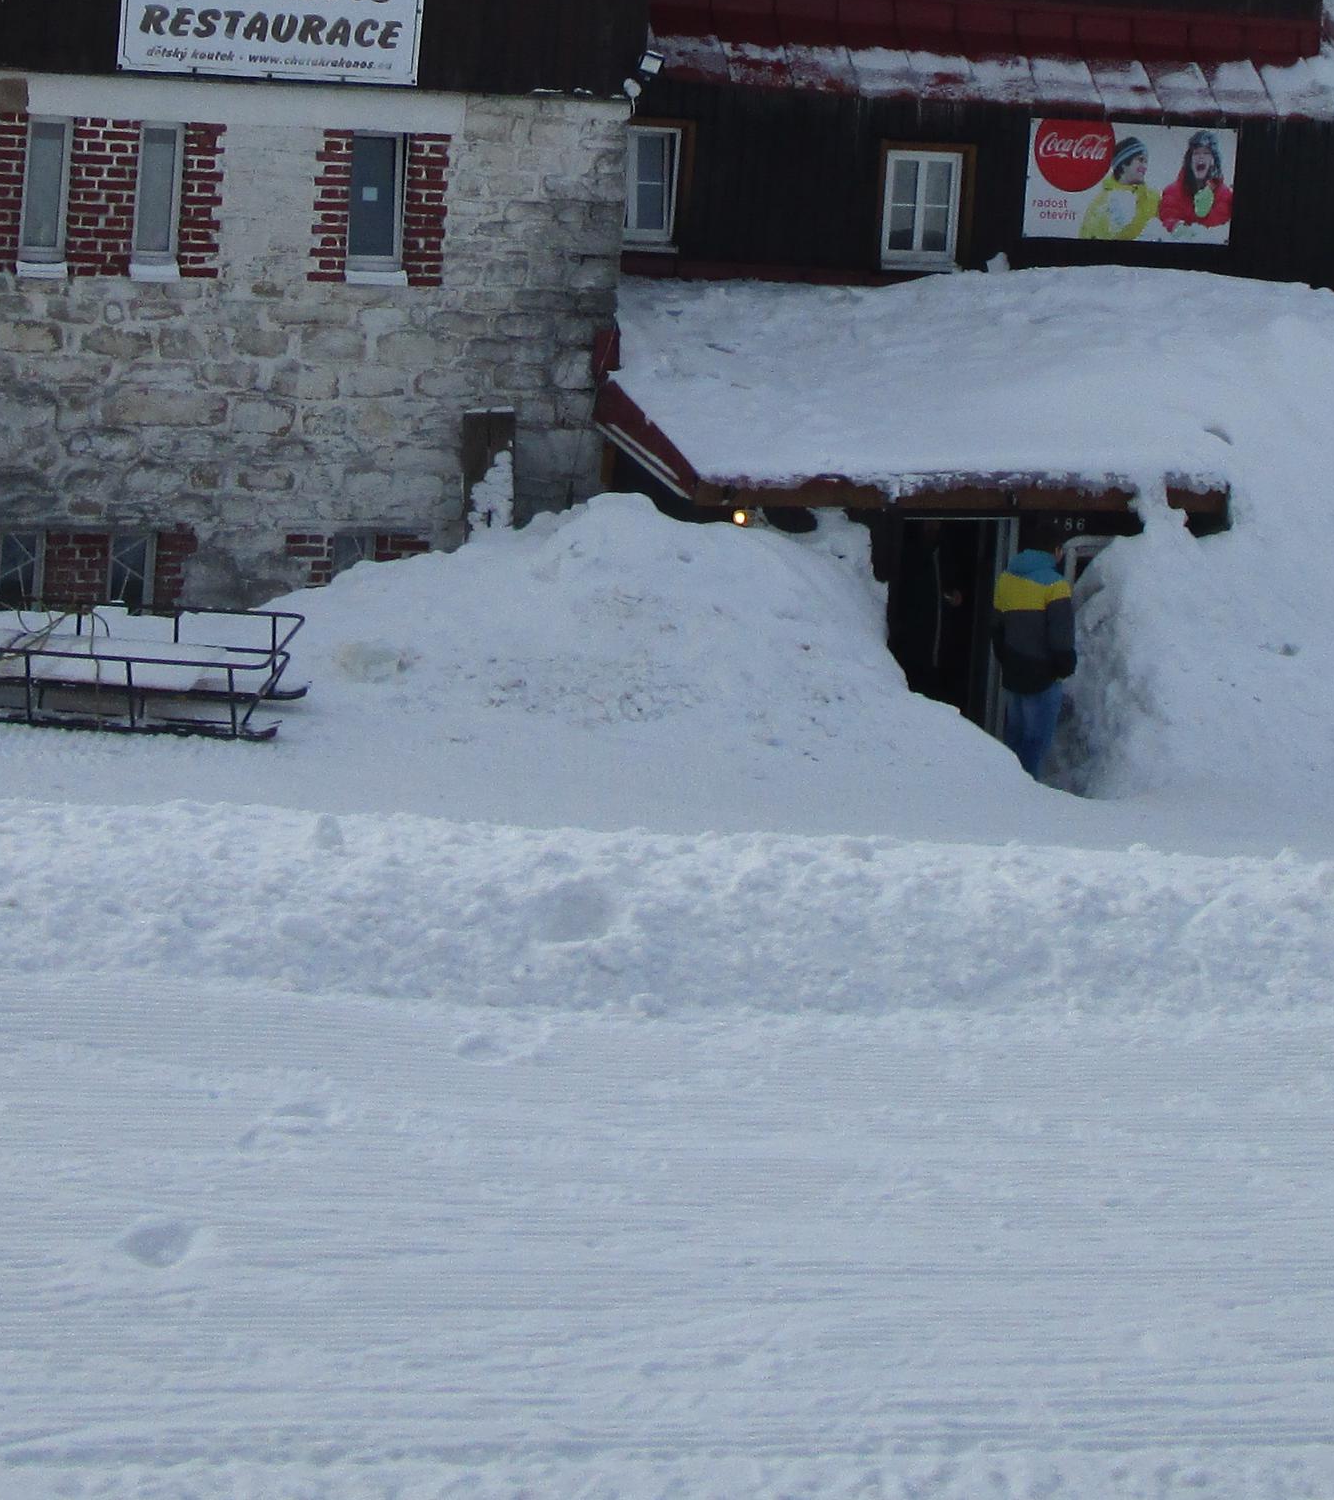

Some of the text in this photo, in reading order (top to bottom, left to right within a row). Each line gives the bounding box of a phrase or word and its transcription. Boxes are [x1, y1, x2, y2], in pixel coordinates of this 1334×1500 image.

[139, 4, 403, 49] RESTAURACE
[146, 45, 188, 61] dětský
[190, 49, 236, 61] koutek
[1039, 131, 1112, 161] Coca-Cola
[1032, 198, 1068, 209] radost
